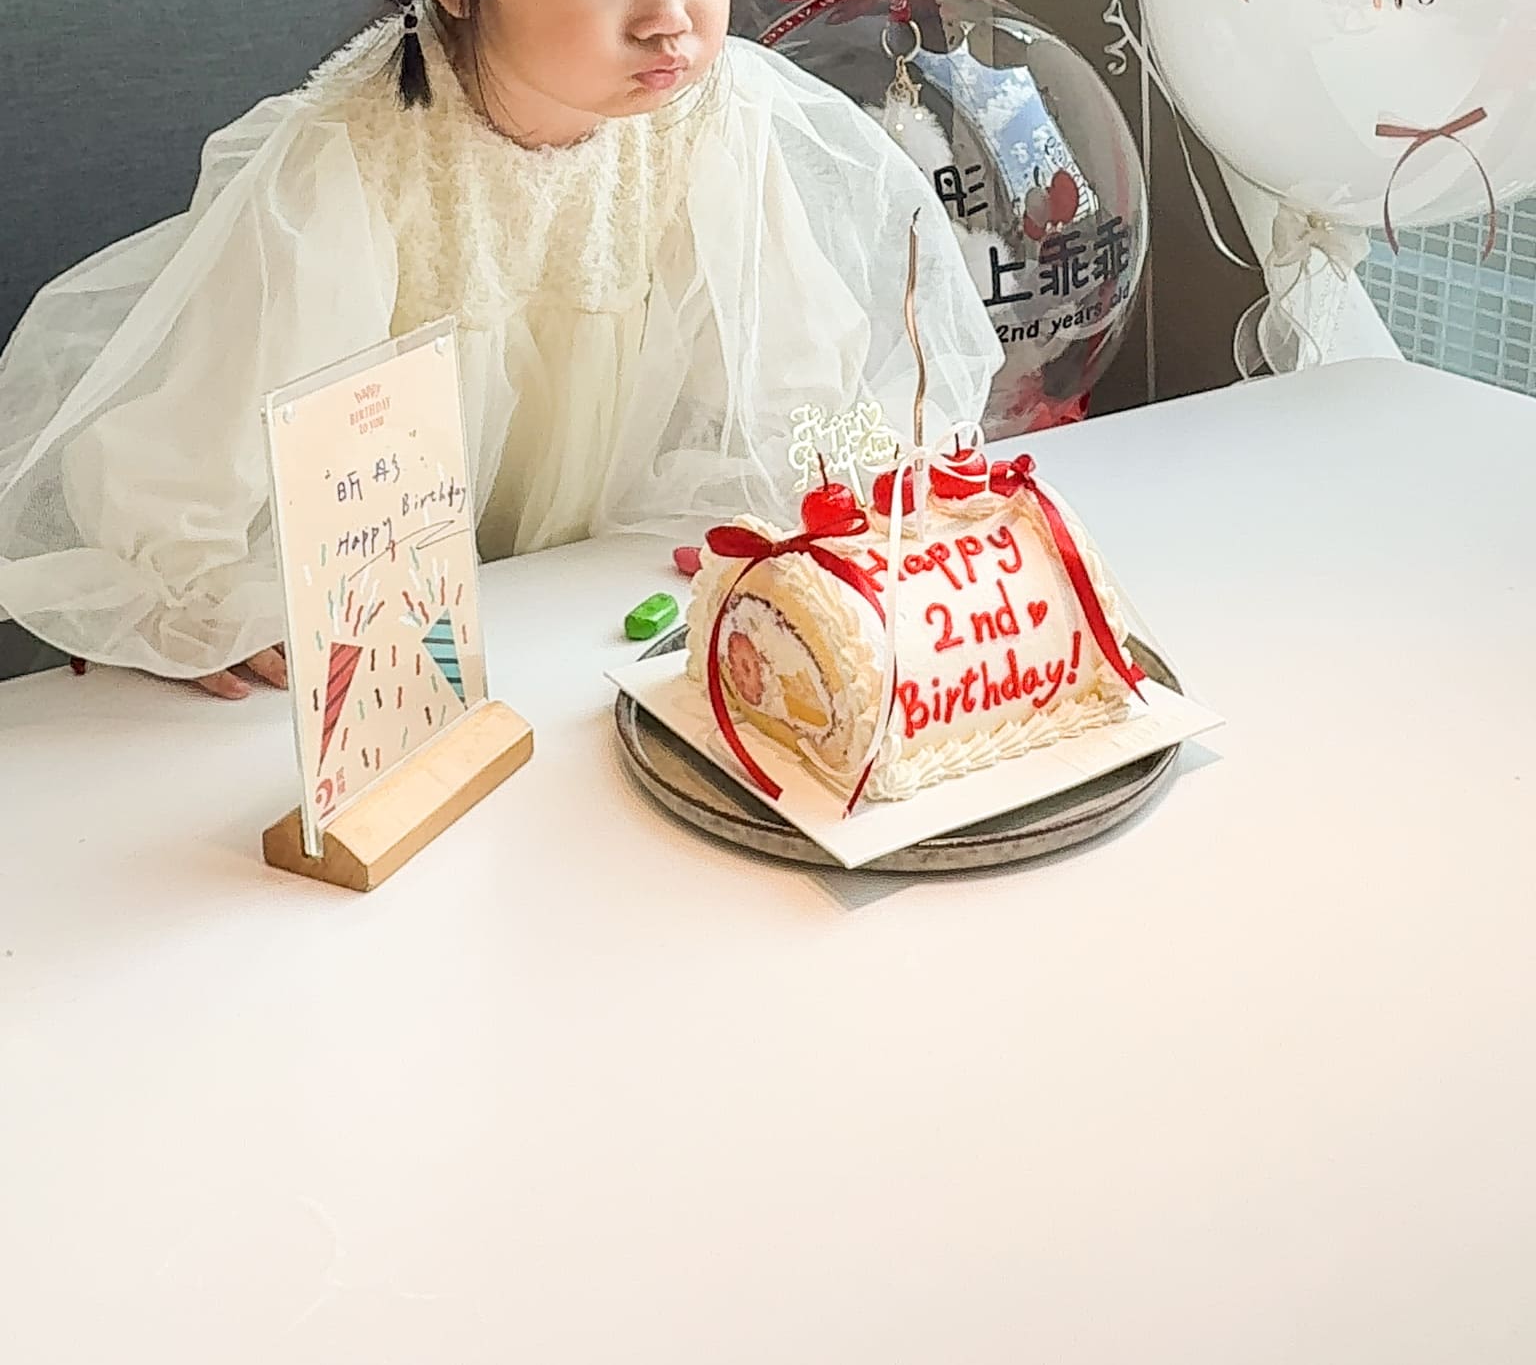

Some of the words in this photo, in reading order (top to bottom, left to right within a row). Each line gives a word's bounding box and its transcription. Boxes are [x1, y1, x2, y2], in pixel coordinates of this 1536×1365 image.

[996, 319, 1040, 343] 2nd
[1050, 302, 1103, 336] years
[335, 516, 395, 558] Happy
[401, 476, 467, 517] Birthday
[853, 525, 1023, 592] Happy
[896, 630, 1083, 739] Birthday!
